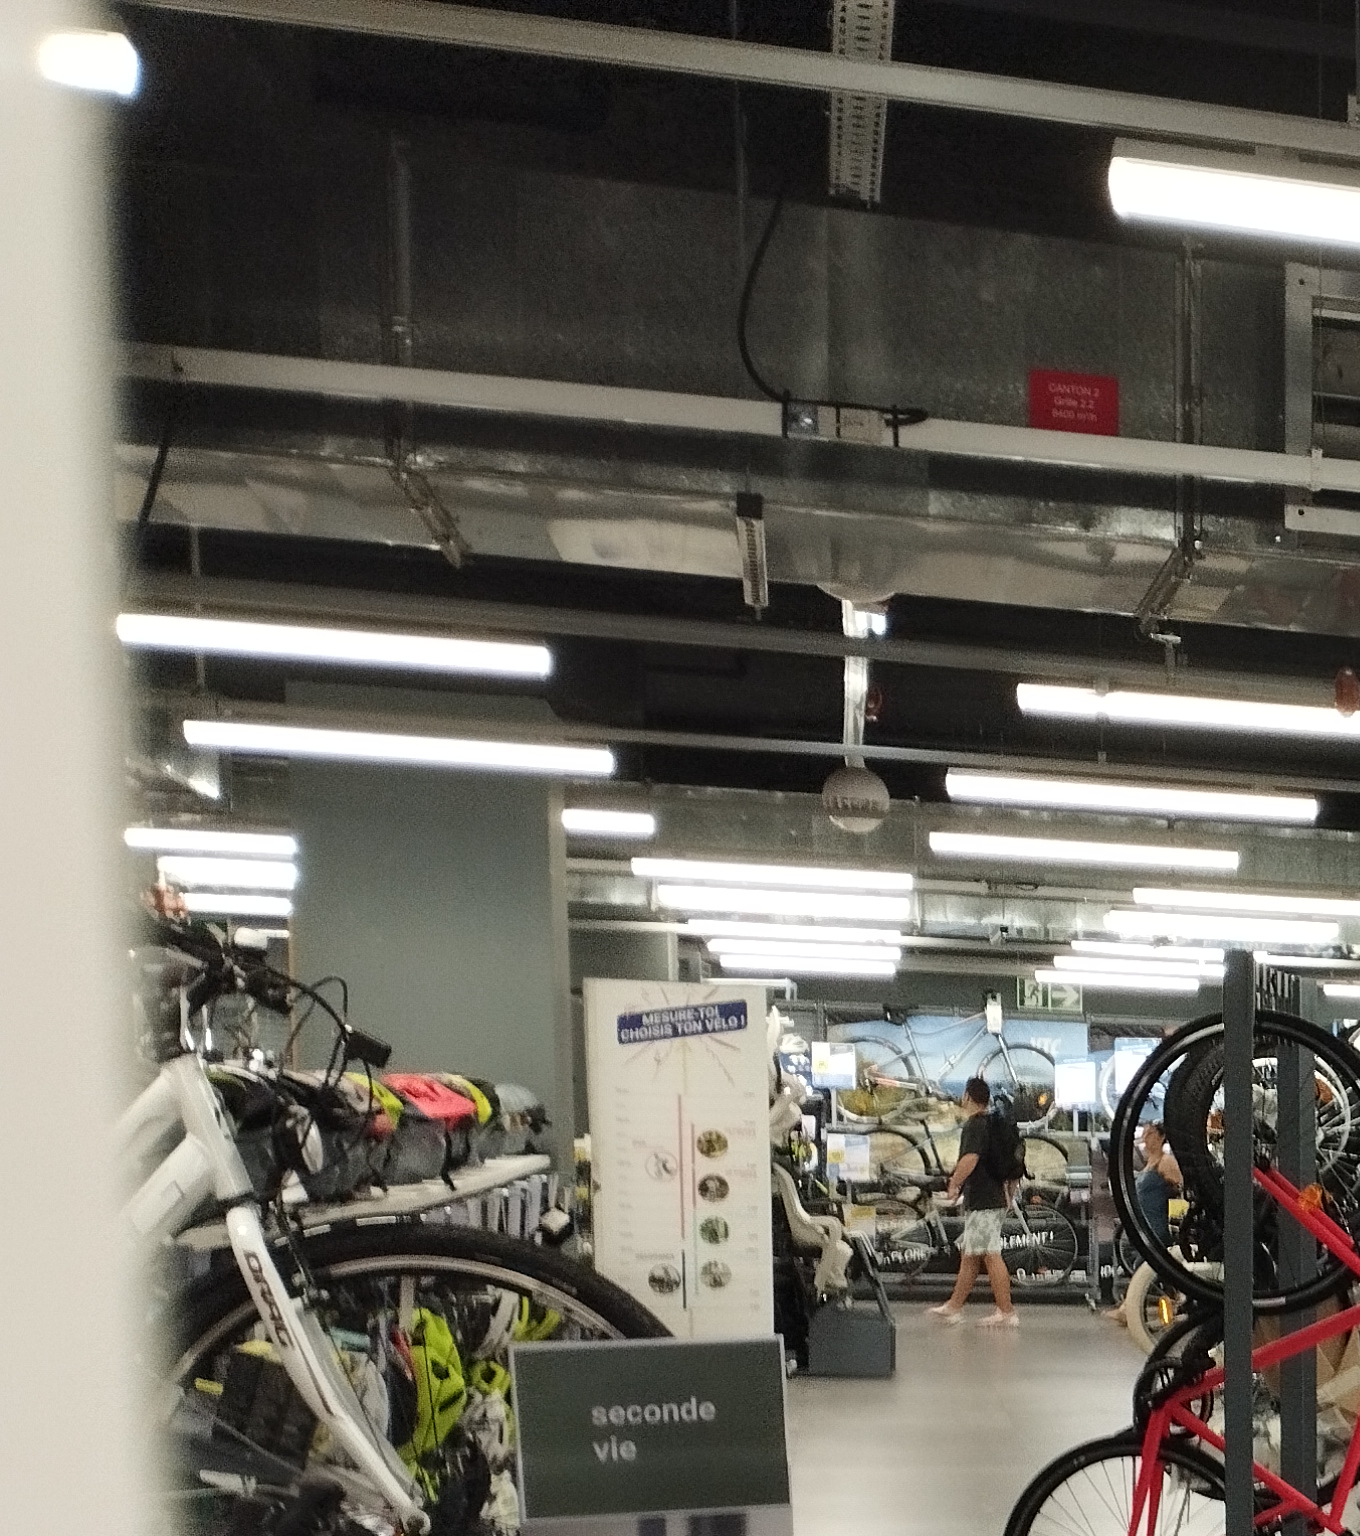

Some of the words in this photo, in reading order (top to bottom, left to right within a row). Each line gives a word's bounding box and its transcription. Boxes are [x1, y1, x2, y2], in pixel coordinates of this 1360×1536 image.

[642, 1005, 719, 1026] MESURE-TOI
[620, 1023, 673, 1042] CHOISIS
[676, 1019, 702, 1036] TON
[591, 1395, 716, 1427] seconde
[592, 1434, 637, 1463] vie
